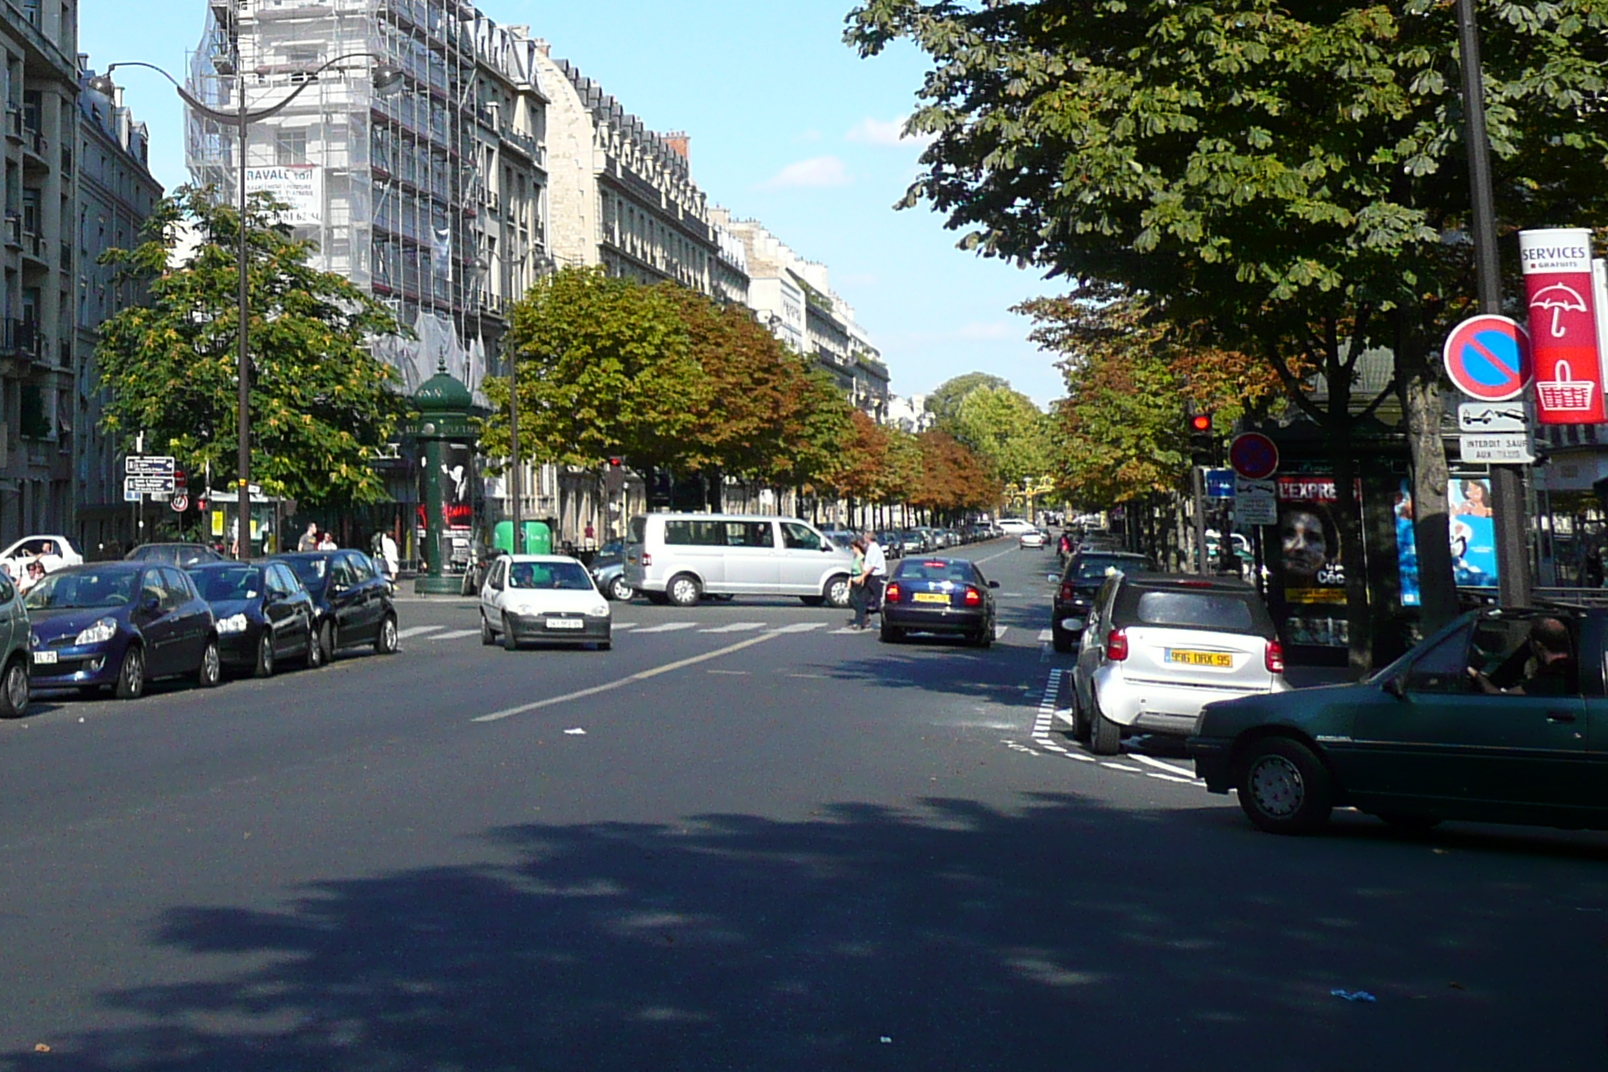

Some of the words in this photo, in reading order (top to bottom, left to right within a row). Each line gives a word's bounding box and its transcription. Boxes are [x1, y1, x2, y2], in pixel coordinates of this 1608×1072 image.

[1522, 246, 1585, 261] SERVICES
[1538, 261, 1578, 269] GRATUITS
[1466, 439, 1501, 449] INTERDIT
[1475, 450, 1492, 459] AUX
[1278, 482, 1357, 500] L'EXPRE
[1317, 570, 1346, 584] Céc
[1216, 655, 1230, 666] 95
